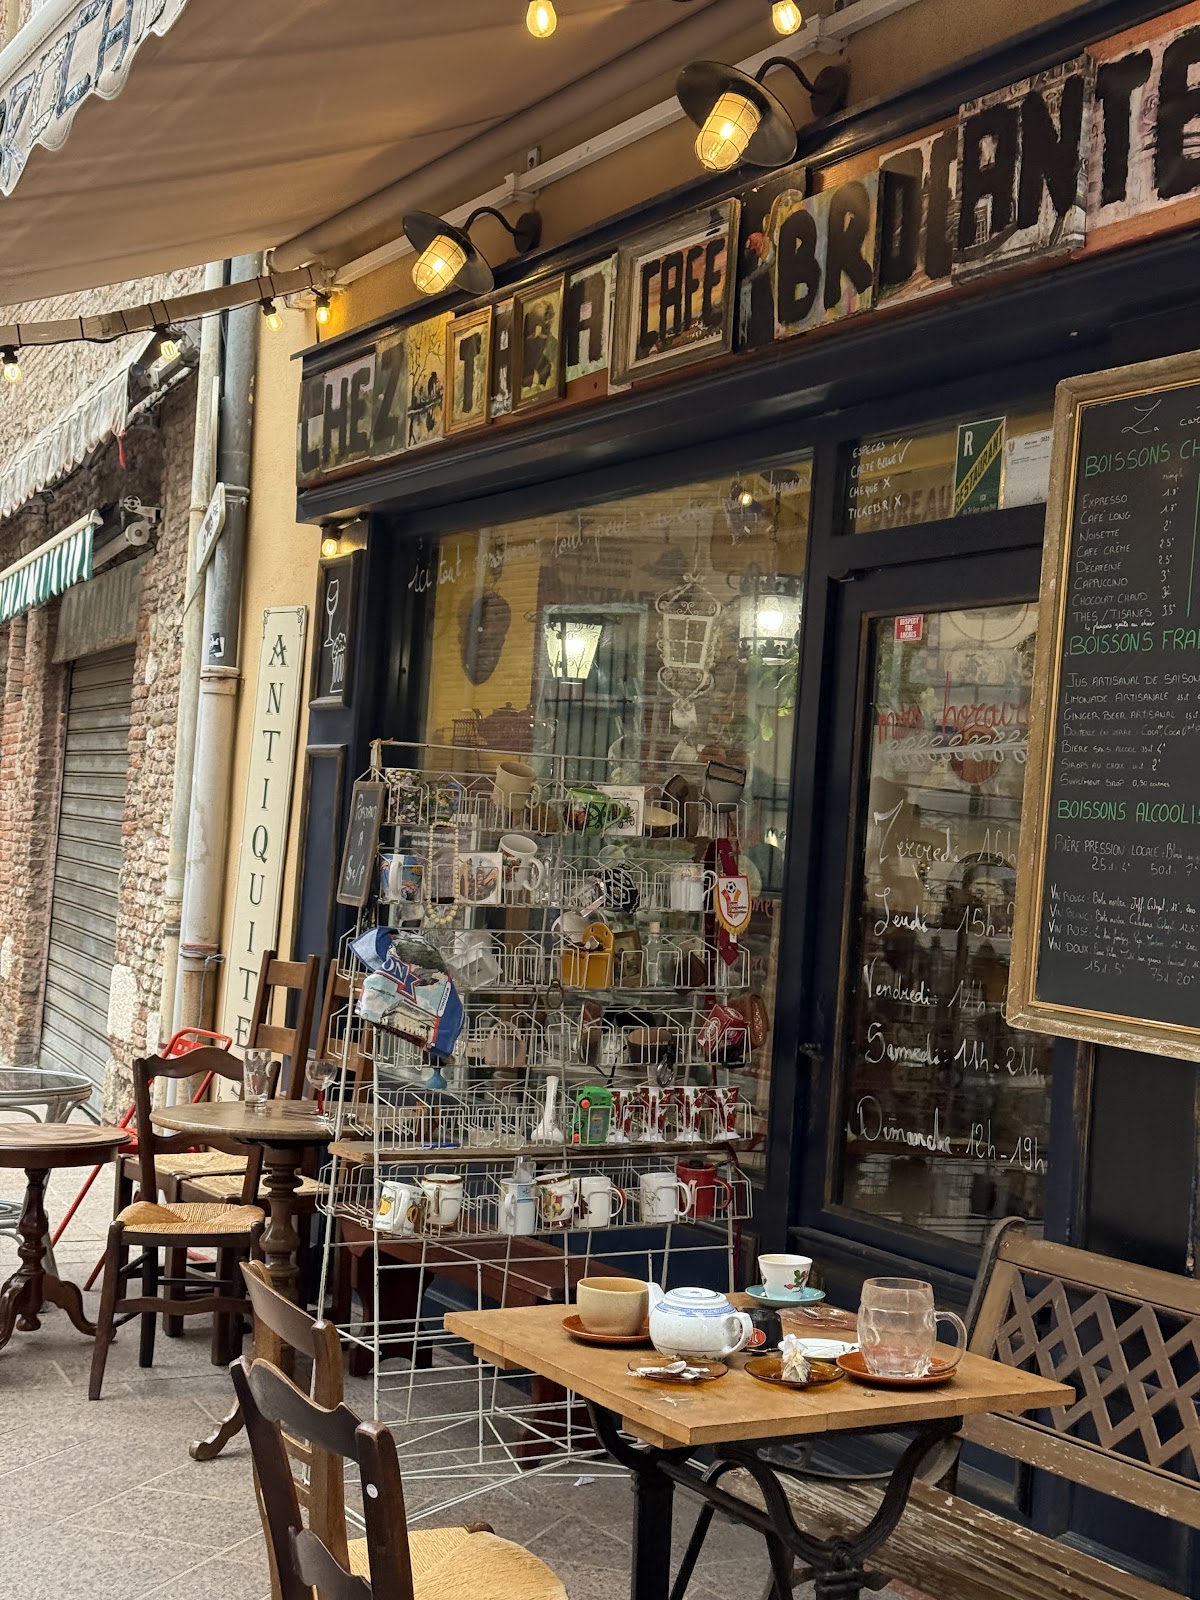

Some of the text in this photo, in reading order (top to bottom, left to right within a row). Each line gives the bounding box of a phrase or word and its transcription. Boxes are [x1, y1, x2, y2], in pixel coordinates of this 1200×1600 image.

[301, 342, 405, 472] CHEZ
[963, 430, 974, 457] R
[1084, 443, 1171, 477] BOISSONS
[850, 462, 875, 479] CARTE
[954, 429, 1003, 512] RESTAURANT
[849, 503, 881, 520] TICKETS
[1108, 511, 1132, 521] LONG
[1079, 528, 1121, 541] NOISETTE
[1072, 594, 1114, 607] CHOCOLAT
[1117, 591, 1148, 604] CHAUD
[1109, 607, 1153, 620] TISANES
[1069, 627, 1200, 656] BOISSONS FRA
[1066, 672, 1088, 688] JUS
[1091, 675, 1140, 687] ARTISANAL
[1143, 675, 1159, 685] DE
[1064, 692, 1108, 705] LIMONADE
[1115, 692, 1169, 703] ARTISANALE
[1063, 707, 1101, 721] GINGER
[1102, 710, 1126, 720] BEER
[1130, 709, 1176, 719] ARTISANAL
[1057, 799, 1200, 824] BOISSONS ALCOOLI
[1054, 833, 1081, 852] BIÈRE
[1084, 839, 1125, 856] PRESSION
[1009, 1135, 1045, 1182] 19h
